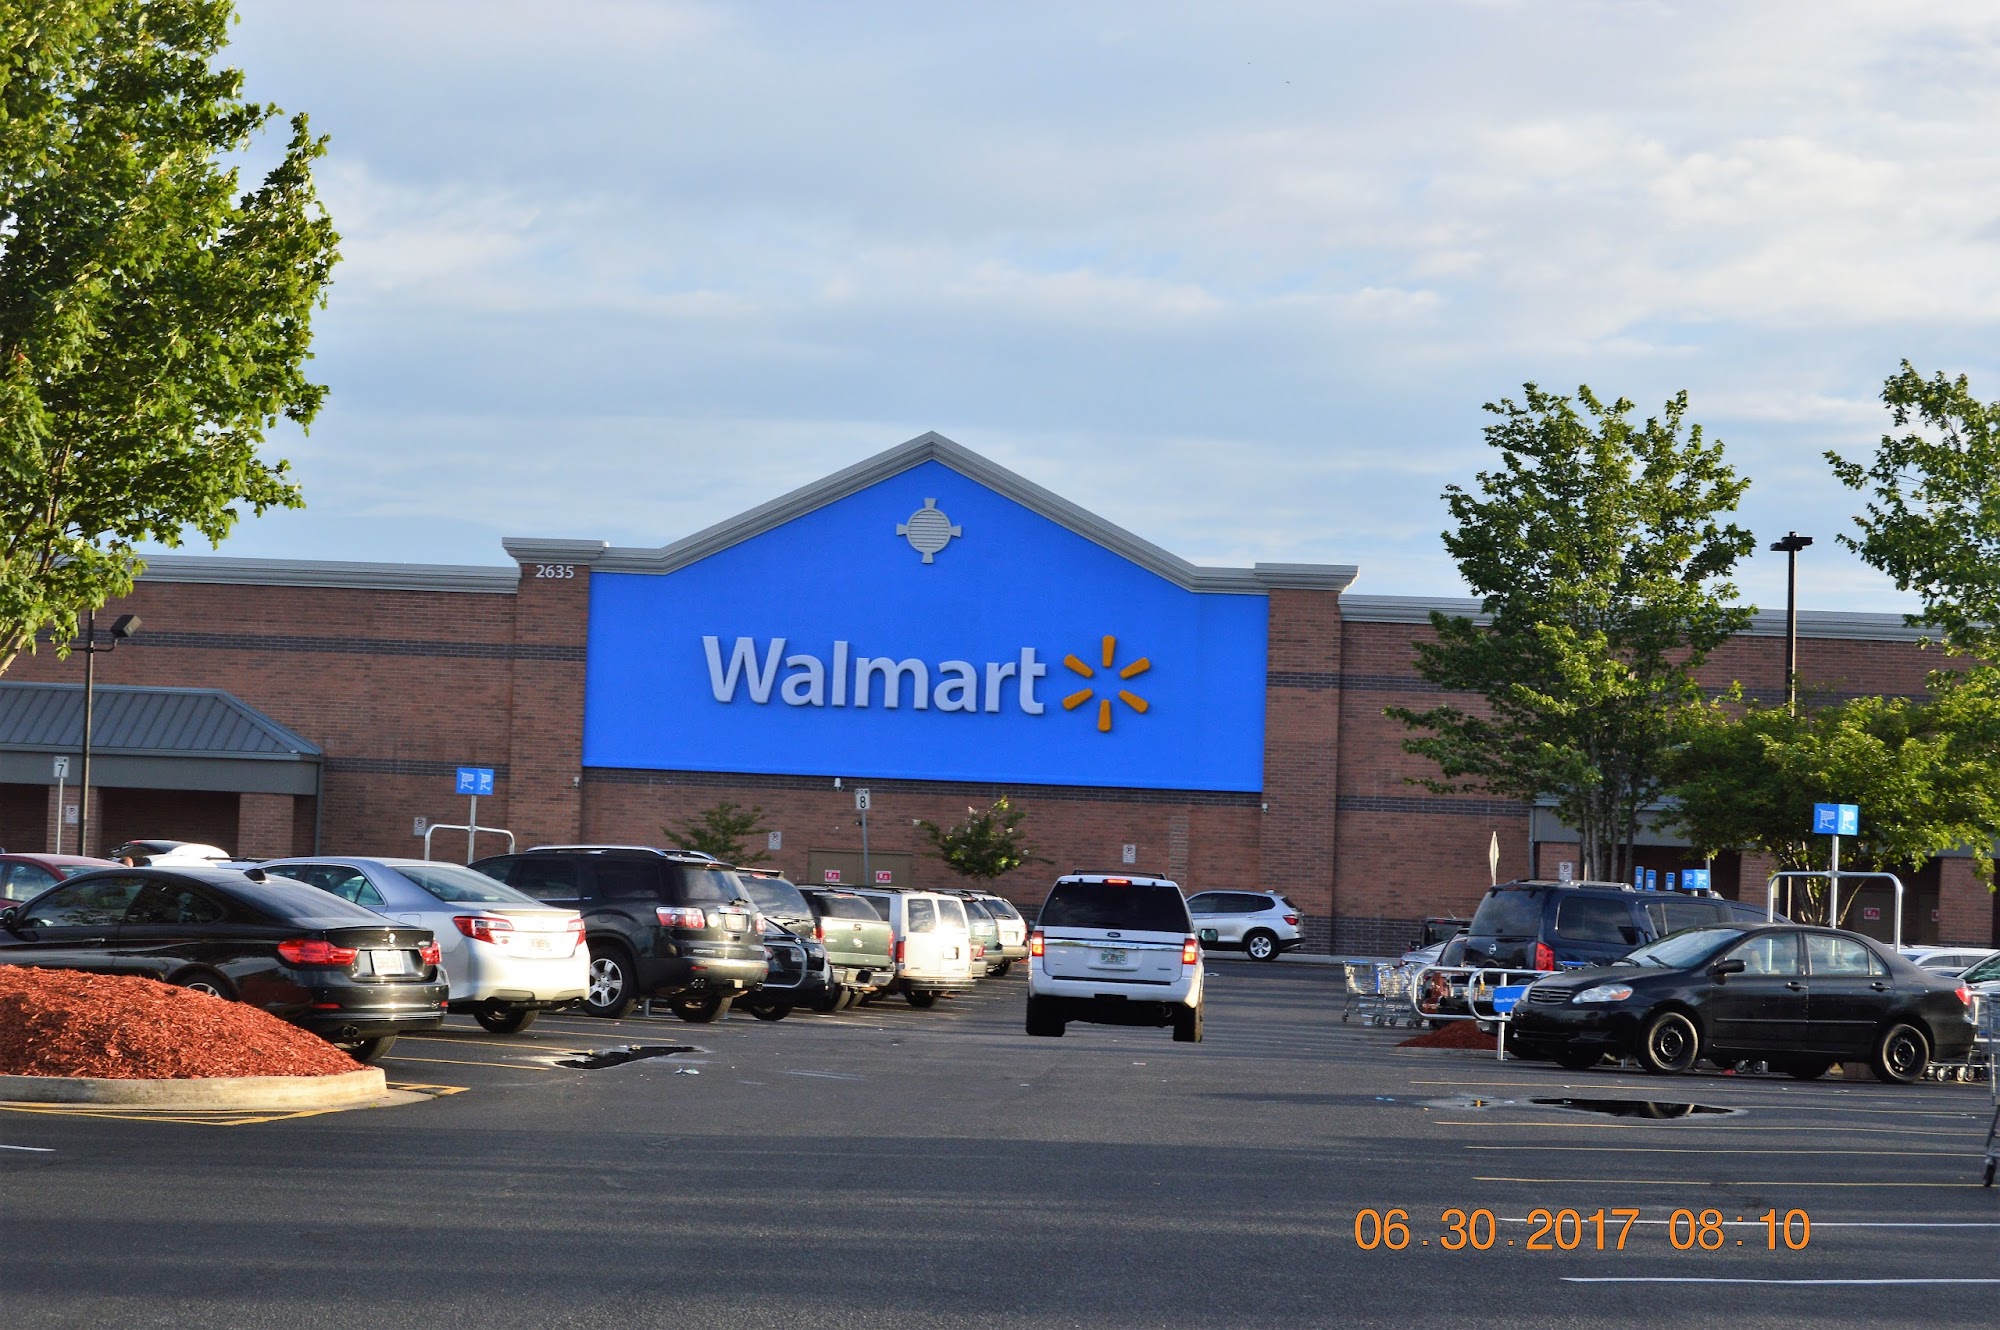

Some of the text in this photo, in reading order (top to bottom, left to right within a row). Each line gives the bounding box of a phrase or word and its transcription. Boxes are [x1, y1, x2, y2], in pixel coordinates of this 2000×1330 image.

[535, 564, 575, 579] 2635
[702, 635, 1047, 715] Walmart
[57, 763, 65, 777] 7
[859, 795, 867, 809] 8
